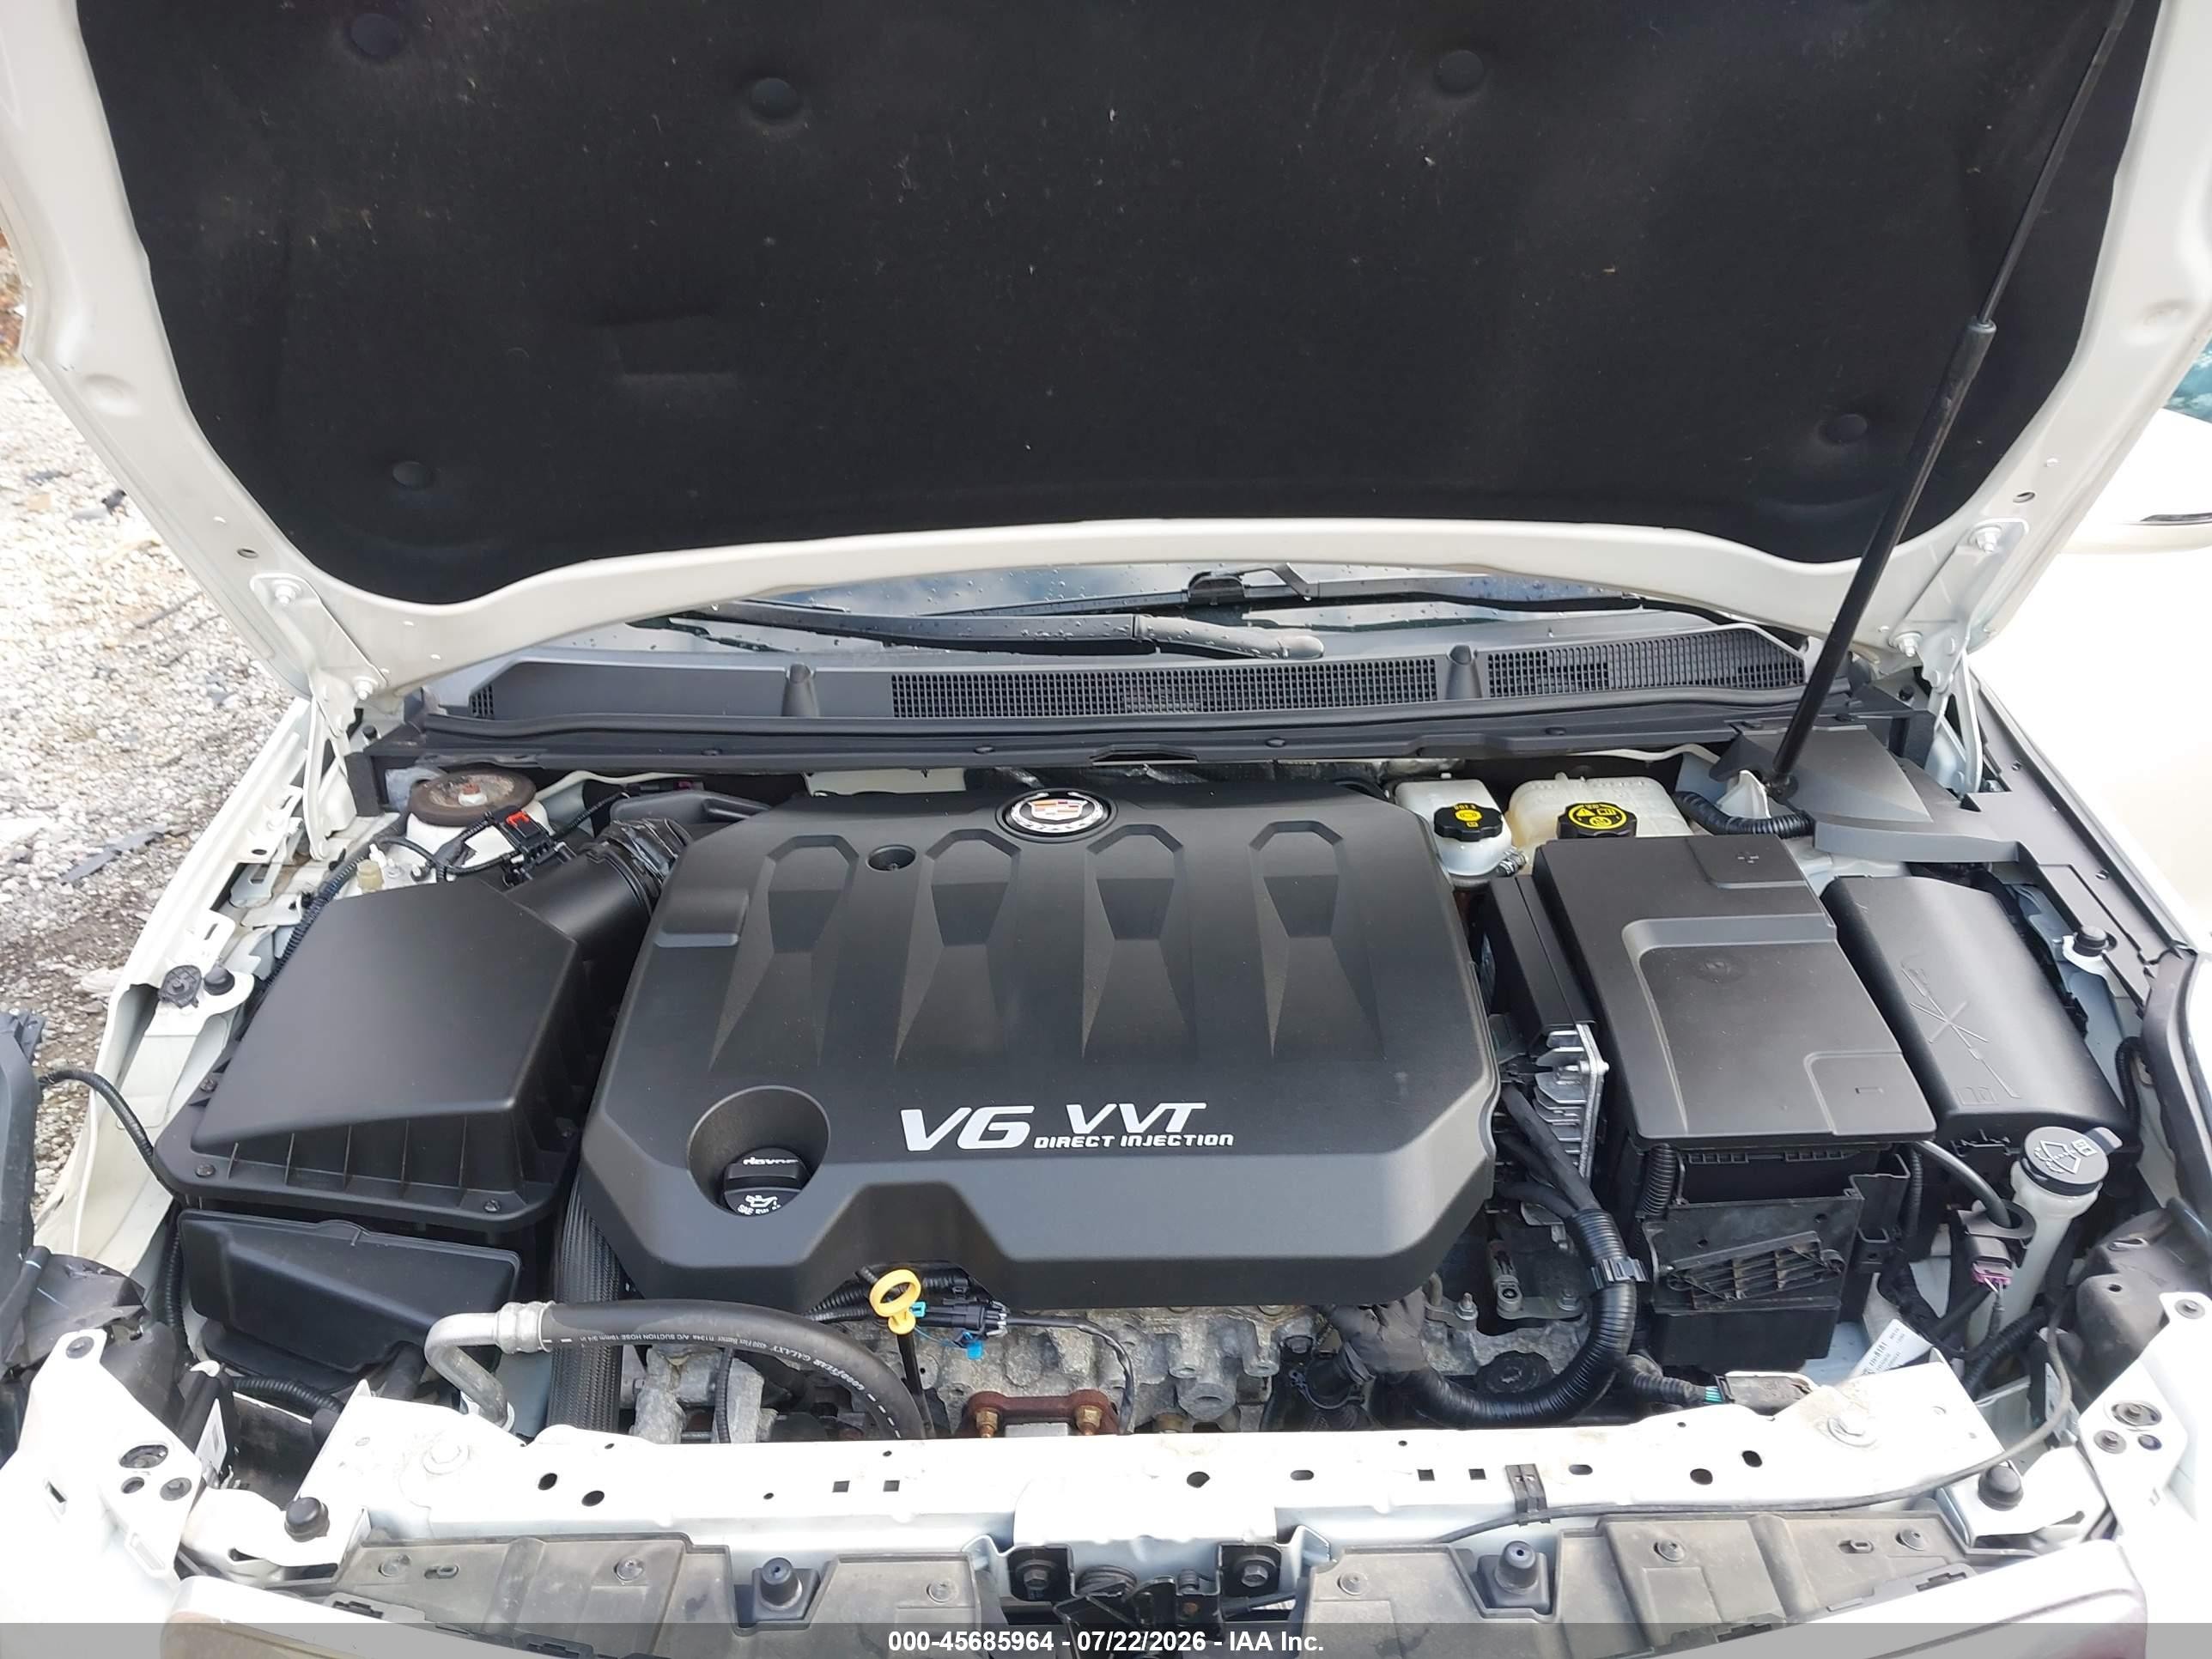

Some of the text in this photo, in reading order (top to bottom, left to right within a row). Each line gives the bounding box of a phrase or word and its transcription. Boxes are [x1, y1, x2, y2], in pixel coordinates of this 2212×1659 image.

[901, 1103, 1206, 1151] V6 VVT
[1034, 1133, 1234, 1149] DIRECT INJECTION
[769, 1345, 811, 1362] GALAXY
[812, 1358, 866, 1391] GOODYEAR
